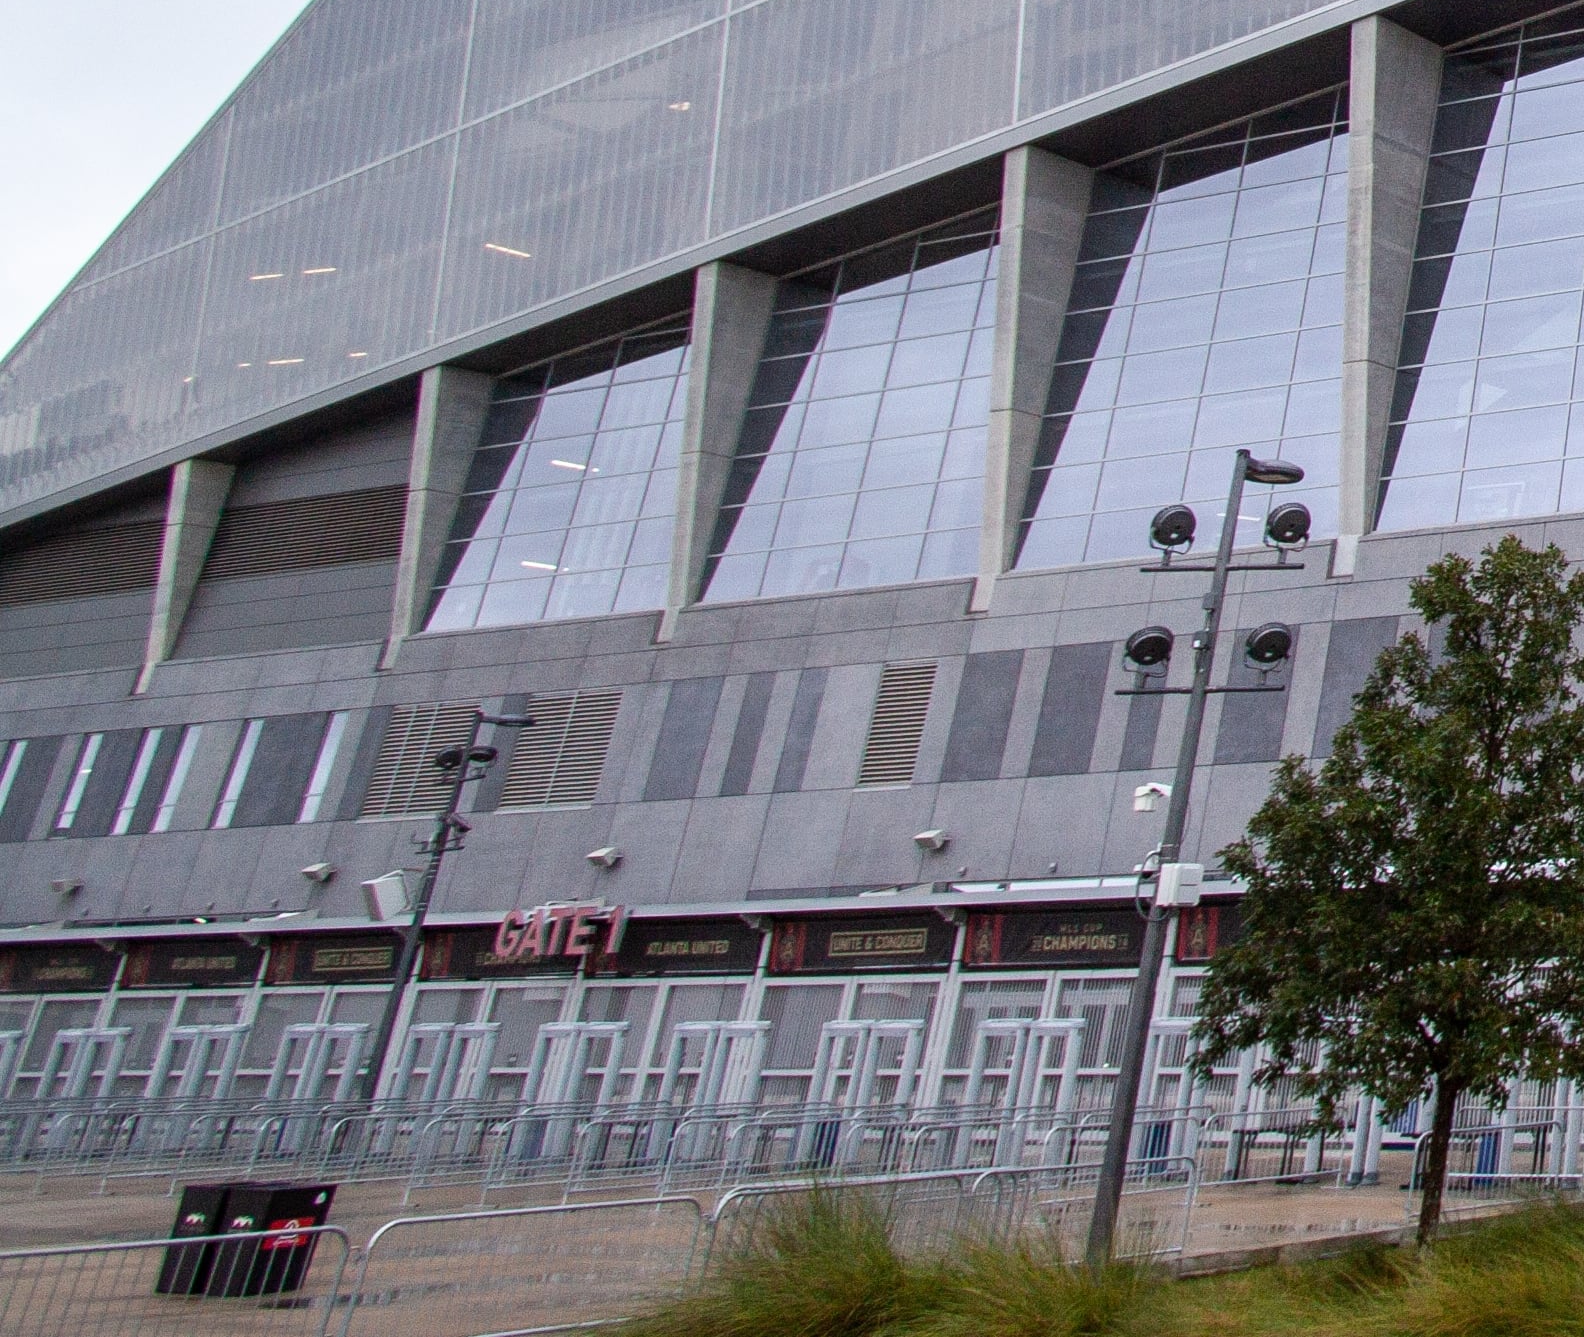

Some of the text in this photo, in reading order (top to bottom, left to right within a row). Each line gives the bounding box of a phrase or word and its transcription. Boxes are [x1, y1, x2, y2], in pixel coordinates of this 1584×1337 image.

[495, 904, 626, 957] GATE 1
[644, 939, 730, 956] ATLANTA UNITED
[833, 936, 863, 951] UNITE
[875, 934, 922, 950] CONQUER
[1043, 934, 1117, 951] CHAMPIONS
